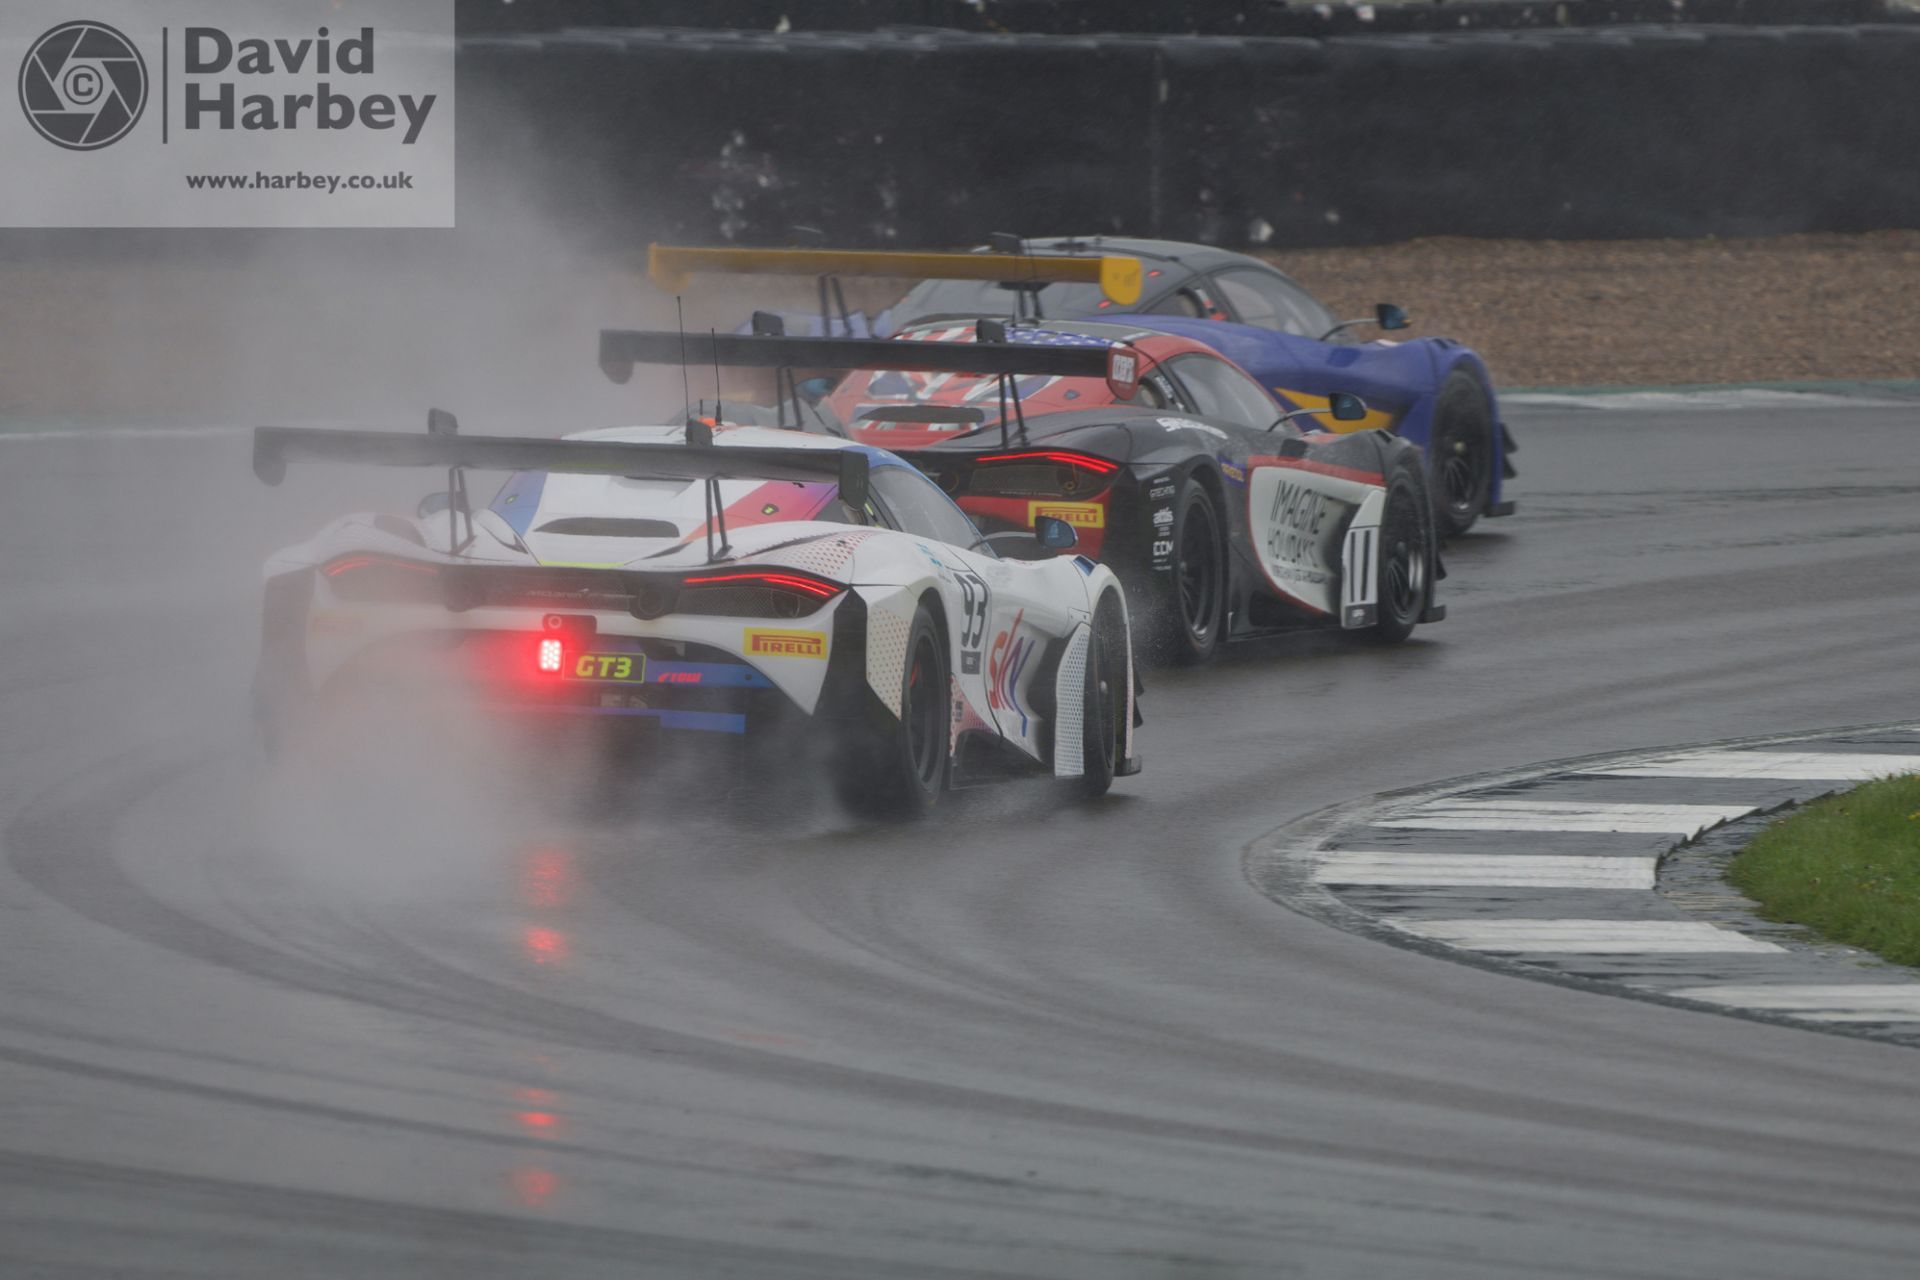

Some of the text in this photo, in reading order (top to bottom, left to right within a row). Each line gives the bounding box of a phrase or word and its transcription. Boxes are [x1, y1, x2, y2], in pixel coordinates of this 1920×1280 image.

[1035, 507, 1097, 523] PRELLI
[1270, 479, 1326, 535] IMAGINE
[1349, 529, 1371, 603] 11
[952, 572, 988, 649] 93
[751, 634, 822, 655] PIRELLI
[575, 655, 632, 678] GT3
